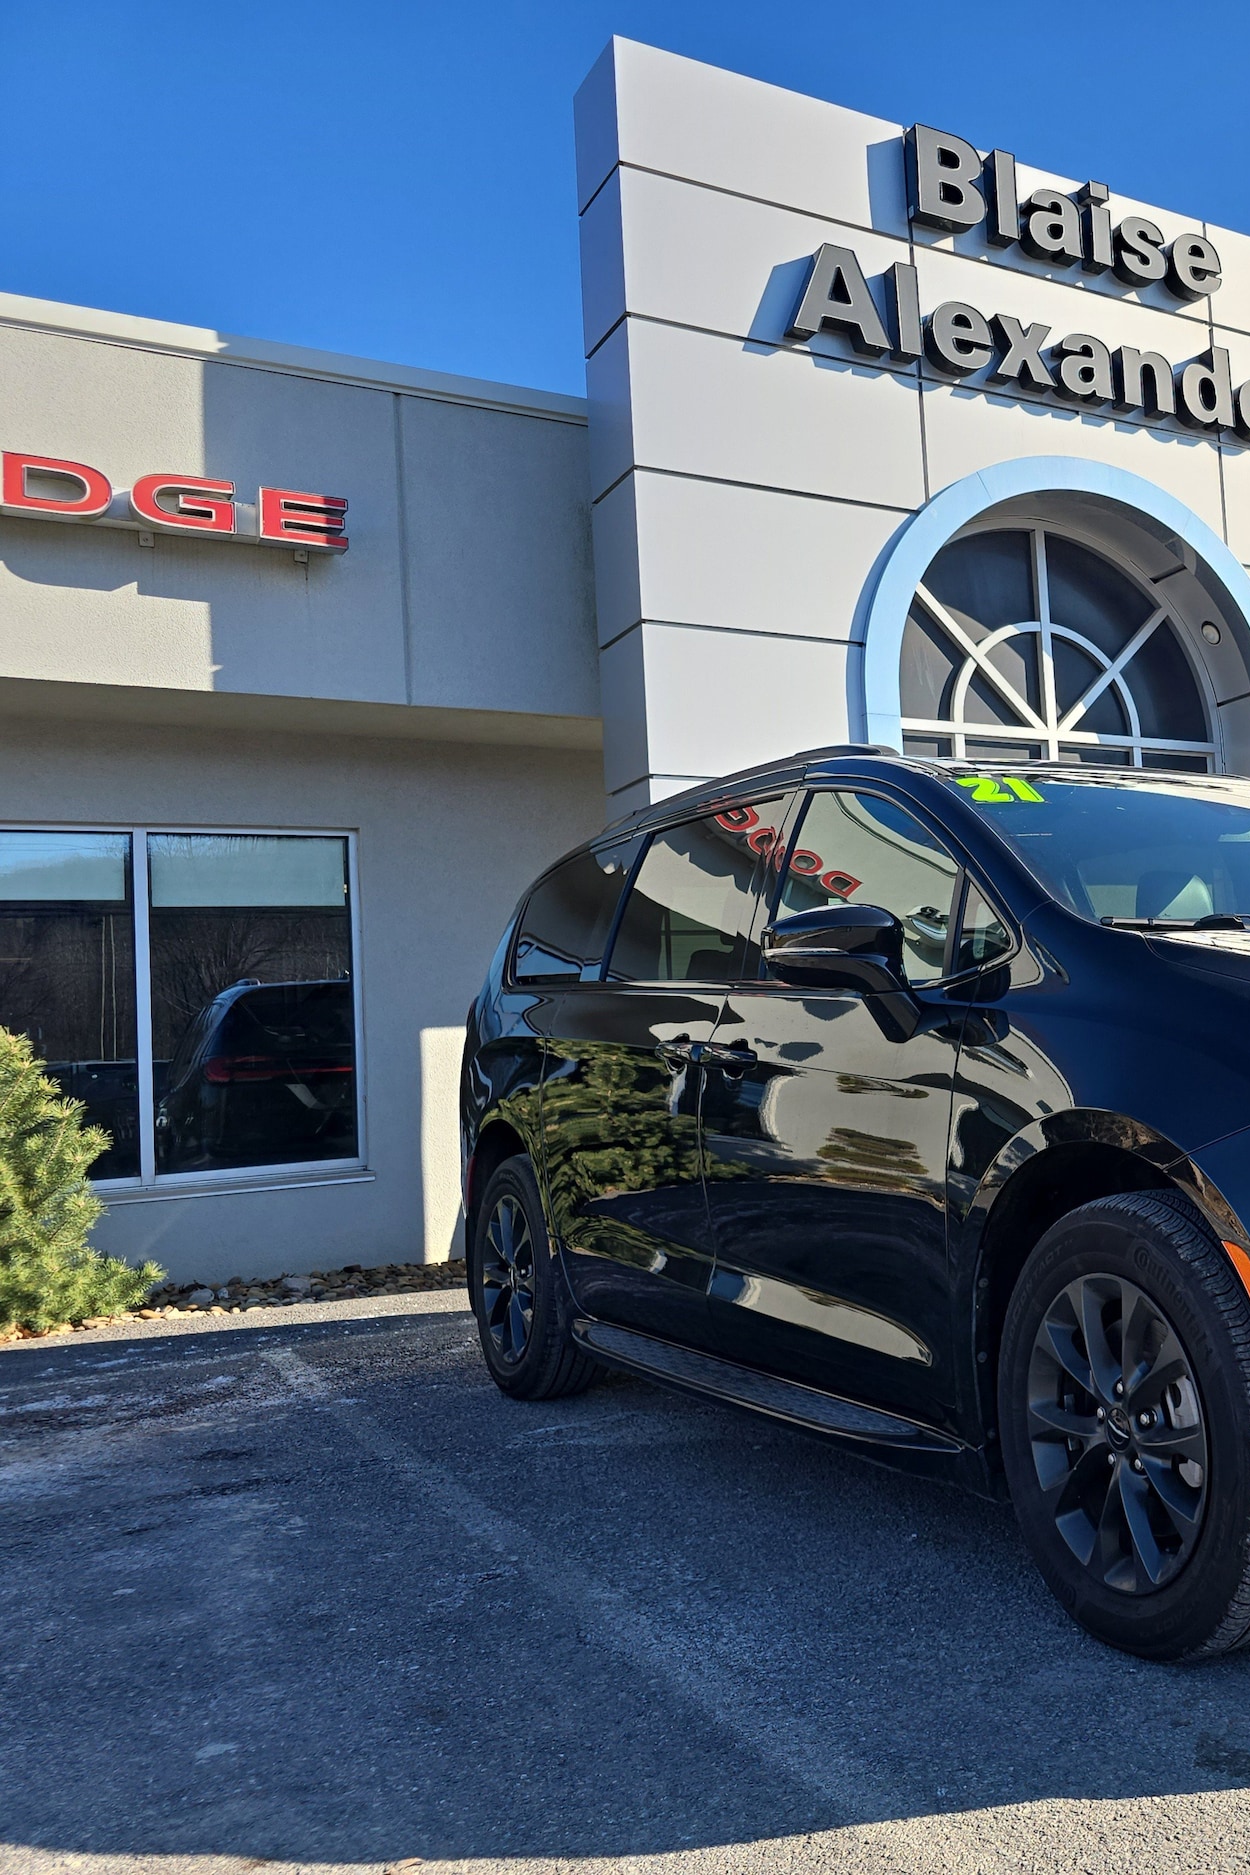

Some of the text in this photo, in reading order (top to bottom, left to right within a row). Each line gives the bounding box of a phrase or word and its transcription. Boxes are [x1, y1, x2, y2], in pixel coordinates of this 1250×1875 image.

[906, 122, 1222, 300] Blaise
[2, 451, 348, 551] DGE
[955, 777, 1045, 802] 21
